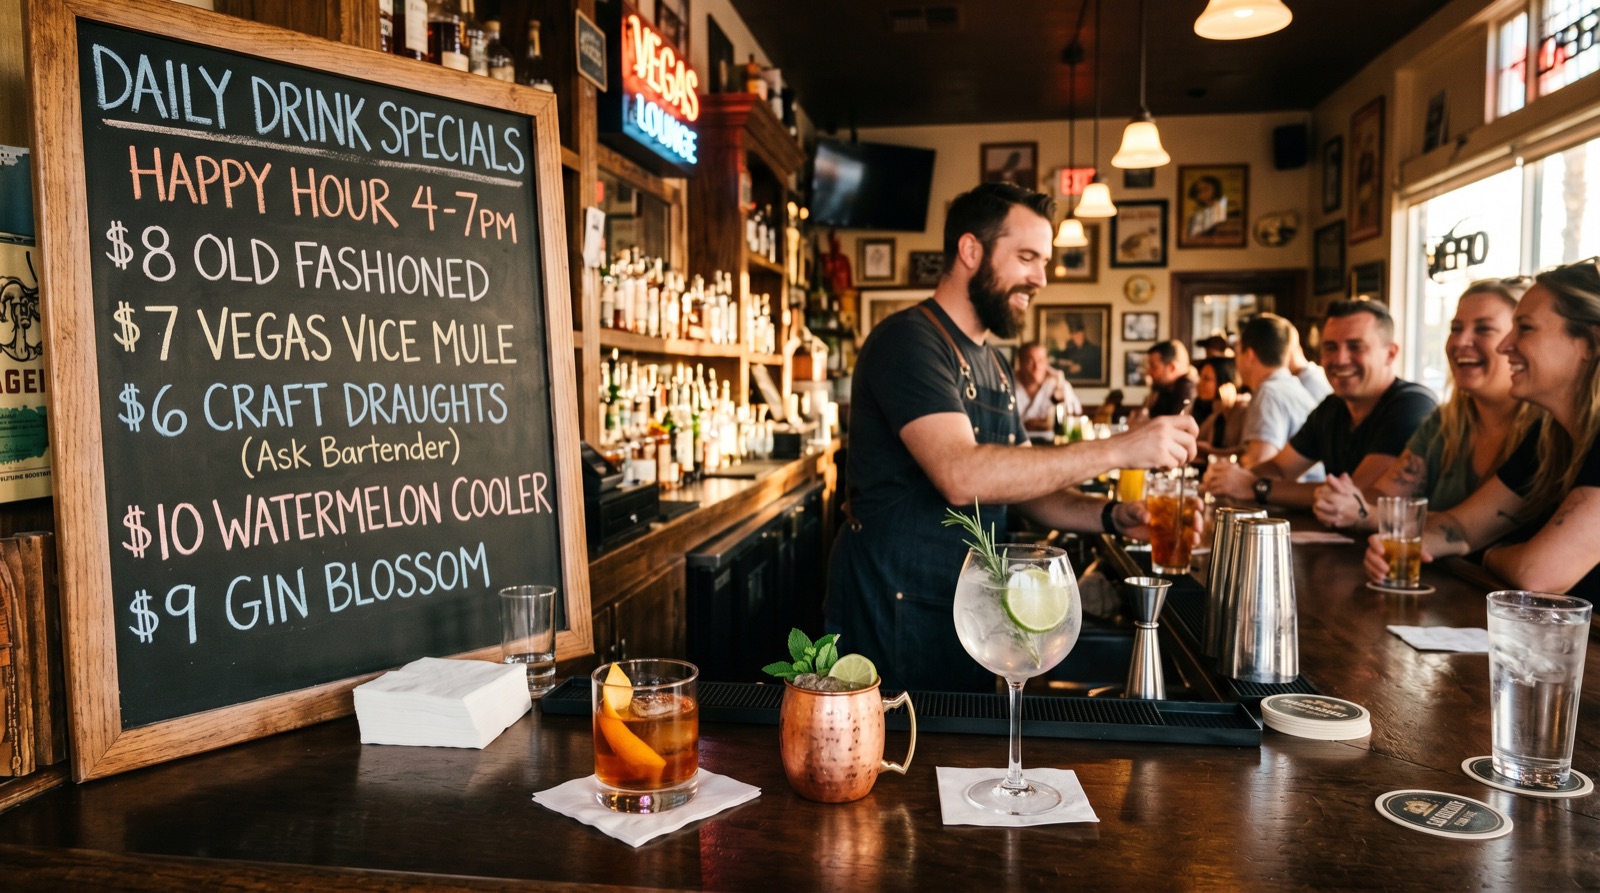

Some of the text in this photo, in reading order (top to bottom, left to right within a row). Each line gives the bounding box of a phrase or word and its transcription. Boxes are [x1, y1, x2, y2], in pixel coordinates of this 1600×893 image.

[92, 44, 524, 175] DAILY DRINK SPECIALS
[628, 15, 698, 121] VEGAS
[636, 93, 697, 164] LOUNGE
[129, 145, 517, 244] HAPPY HOUR 4-7PM
[106, 220, 489, 302] $8 OLD FASHIONED
[113, 301, 518, 366] $7 VEGAS VICE MULE
[118, 382, 508, 437] $6 CRAFT DRAUGHTS
[242, 427, 460, 478] (Ask Bartender)
[122, 472, 552, 560] $10 WATERMELON COOLER
[129, 542, 490, 644] $9 GIN BLOSSOM
